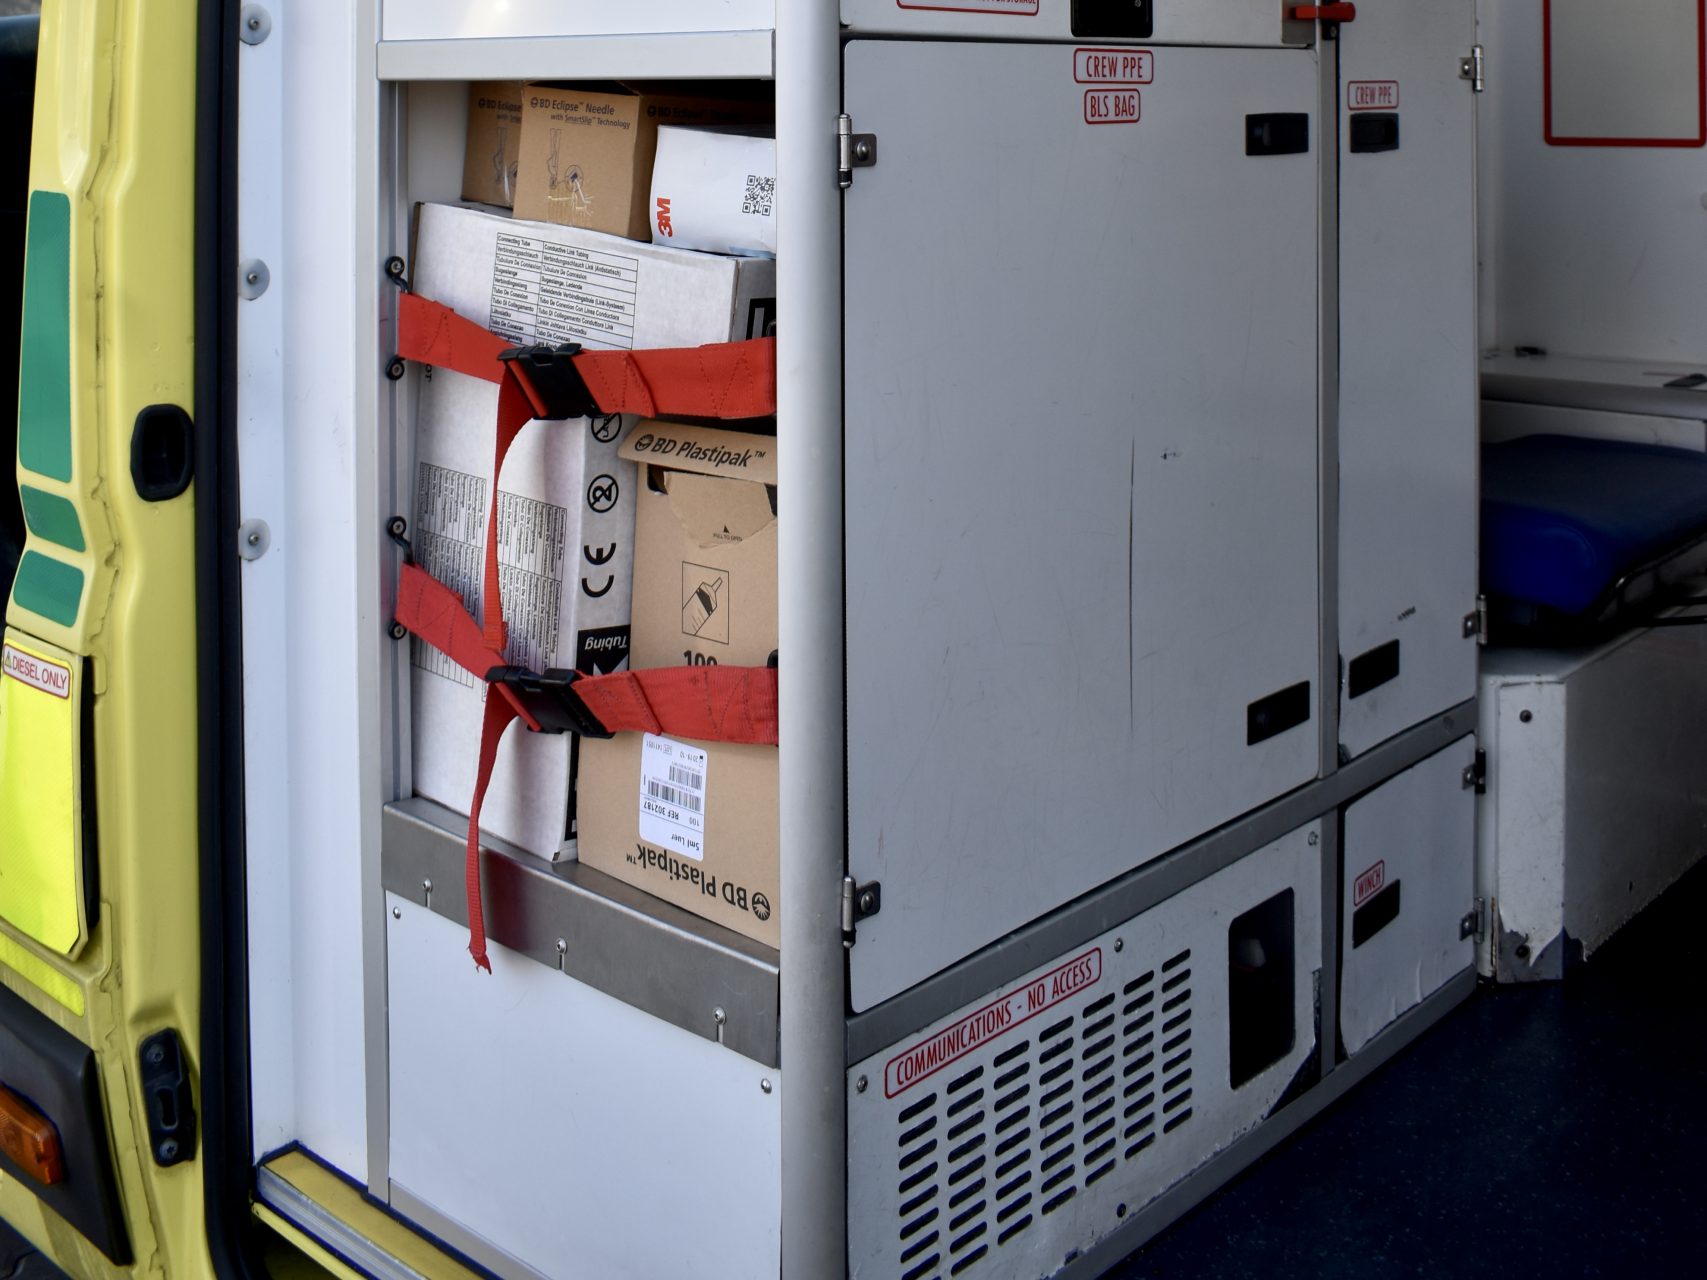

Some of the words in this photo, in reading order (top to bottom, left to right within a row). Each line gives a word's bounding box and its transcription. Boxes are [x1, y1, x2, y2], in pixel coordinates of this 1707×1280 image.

[1086, 55, 1118, 78] CREW
[1122, 57, 1143, 78] PPE
[1356, 86, 1376, 104] CREW
[1378, 86, 1392, 104] PPE
[486, 100, 496, 109] BD
[540, 98, 551, 109] BD
[586, 103, 614, 115] Needle
[1090, 95, 1109, 117] BLS
[1114, 95, 1135, 117] BAG
[597, 118, 630, 129] Technology
[656, 197, 673, 238] 3M
[544, 244, 566, 254] Conductive
[576, 251, 589, 259] Tubing
[652, 437, 676, 454] BD
[676, 441, 766, 468] Plastipak™
[585, 635, 627, 651] Tubing
[13, 656, 40, 681] DIESEL
[42, 669, 67, 689] ONLY
[644, 801, 666, 815] 302187
[667, 810, 679, 820] REF
[689, 816, 699, 826] 100
[671, 833, 685, 845] Luer
[687, 838, 699, 851] 5ml
[626, 843, 716, 897] Plastipak™
[1358, 867, 1381, 899] WINCH
[722, 882, 748, 911] BD
[897, 1000, 1011, 1086] COMMUNICATIONS
[1028, 983, 1045, 1012] NO
[1052, 958, 1092, 999] ACCESS
